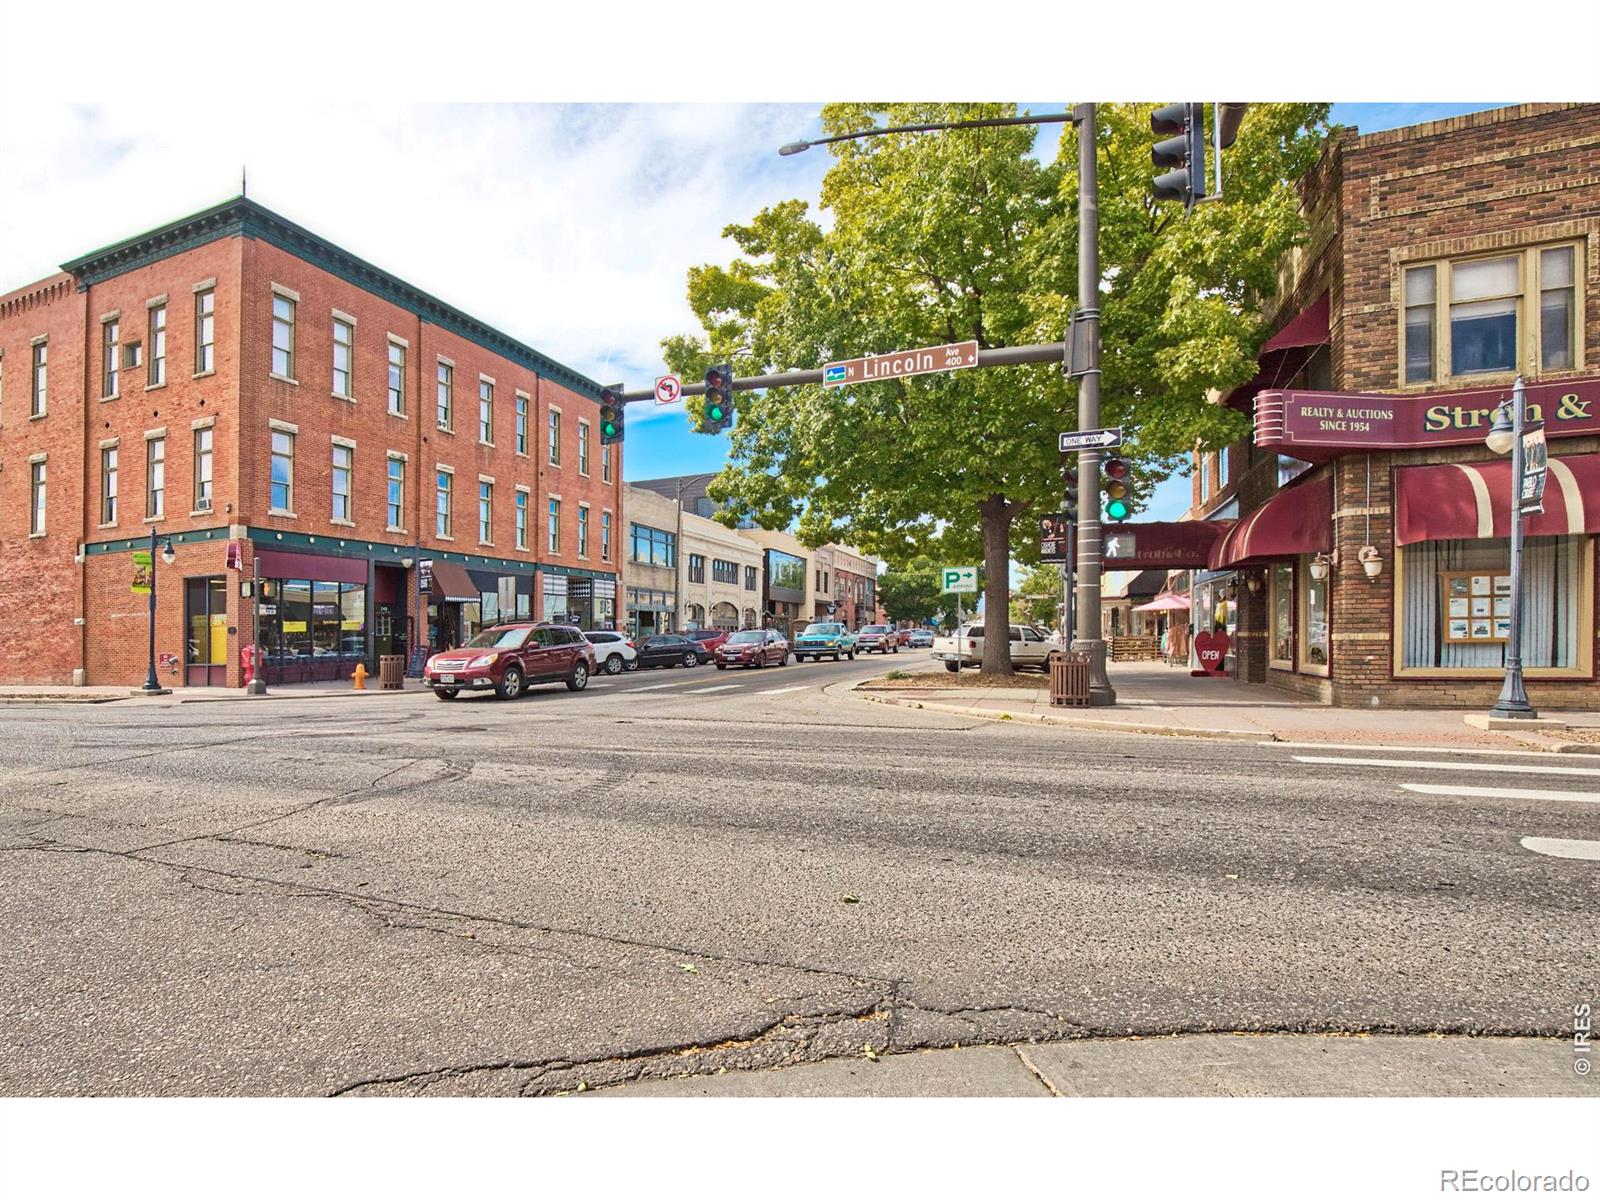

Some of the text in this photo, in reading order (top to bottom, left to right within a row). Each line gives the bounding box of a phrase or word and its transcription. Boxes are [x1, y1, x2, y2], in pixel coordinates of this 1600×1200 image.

[945, 348, 960, 357] Ave
[848, 353, 933, 378] N Lincoln
[944, 356, 962, 366] 400
[1557, 393, 1593, 420] &
[1301, 406, 1394, 420] REALTY & AUCTIONS
[1320, 420, 1370, 432] SINCE 1954
[1065, 435, 1102, 445] ONE WAY
[1202, 650, 1220, 660] OPEN
